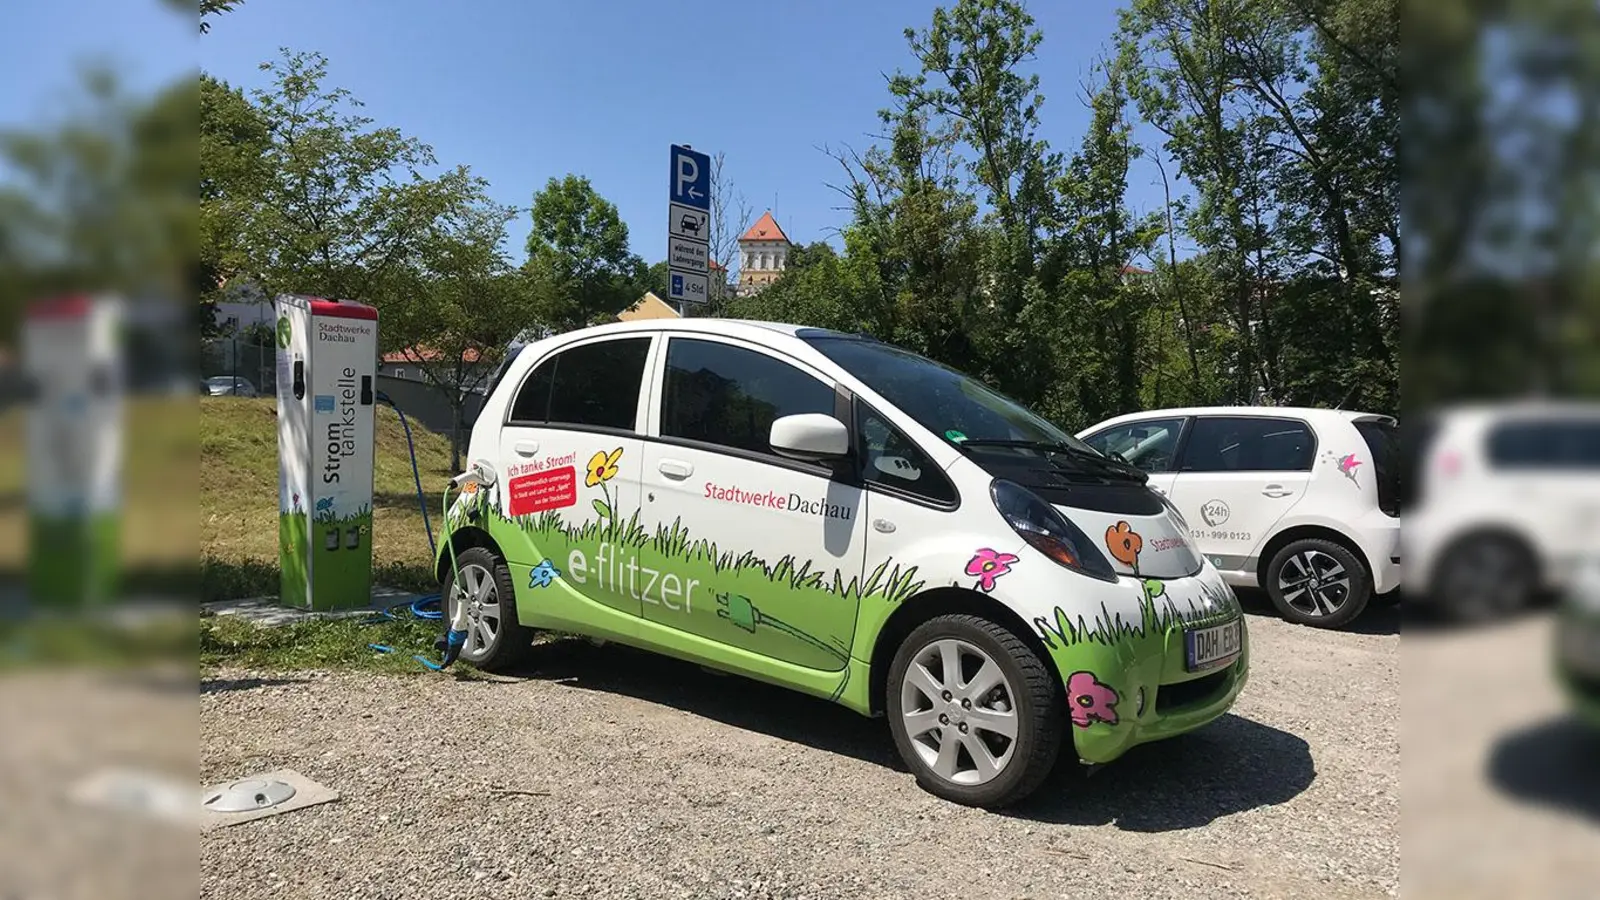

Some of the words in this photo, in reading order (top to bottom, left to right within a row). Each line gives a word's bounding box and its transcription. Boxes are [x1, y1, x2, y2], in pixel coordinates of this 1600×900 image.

[677, 154, 699, 197] P
[685, 282, 690, 292] 4
[318, 322, 371, 336] Stadtwerke
[319, 332, 356, 343] Dachau
[338, 367, 356, 458] tankstelle
[323, 422, 341, 484] Strom
[507, 464, 519, 477] Ich
[520, 459, 544, 474] tanke
[546, 451, 576, 469] Strom!
[1208, 505, 1228, 517] 24h
[1211, 531, 1228, 539] 999
[1230, 532, 1251, 541] 0123
[1196, 629, 1219, 661] DAH
